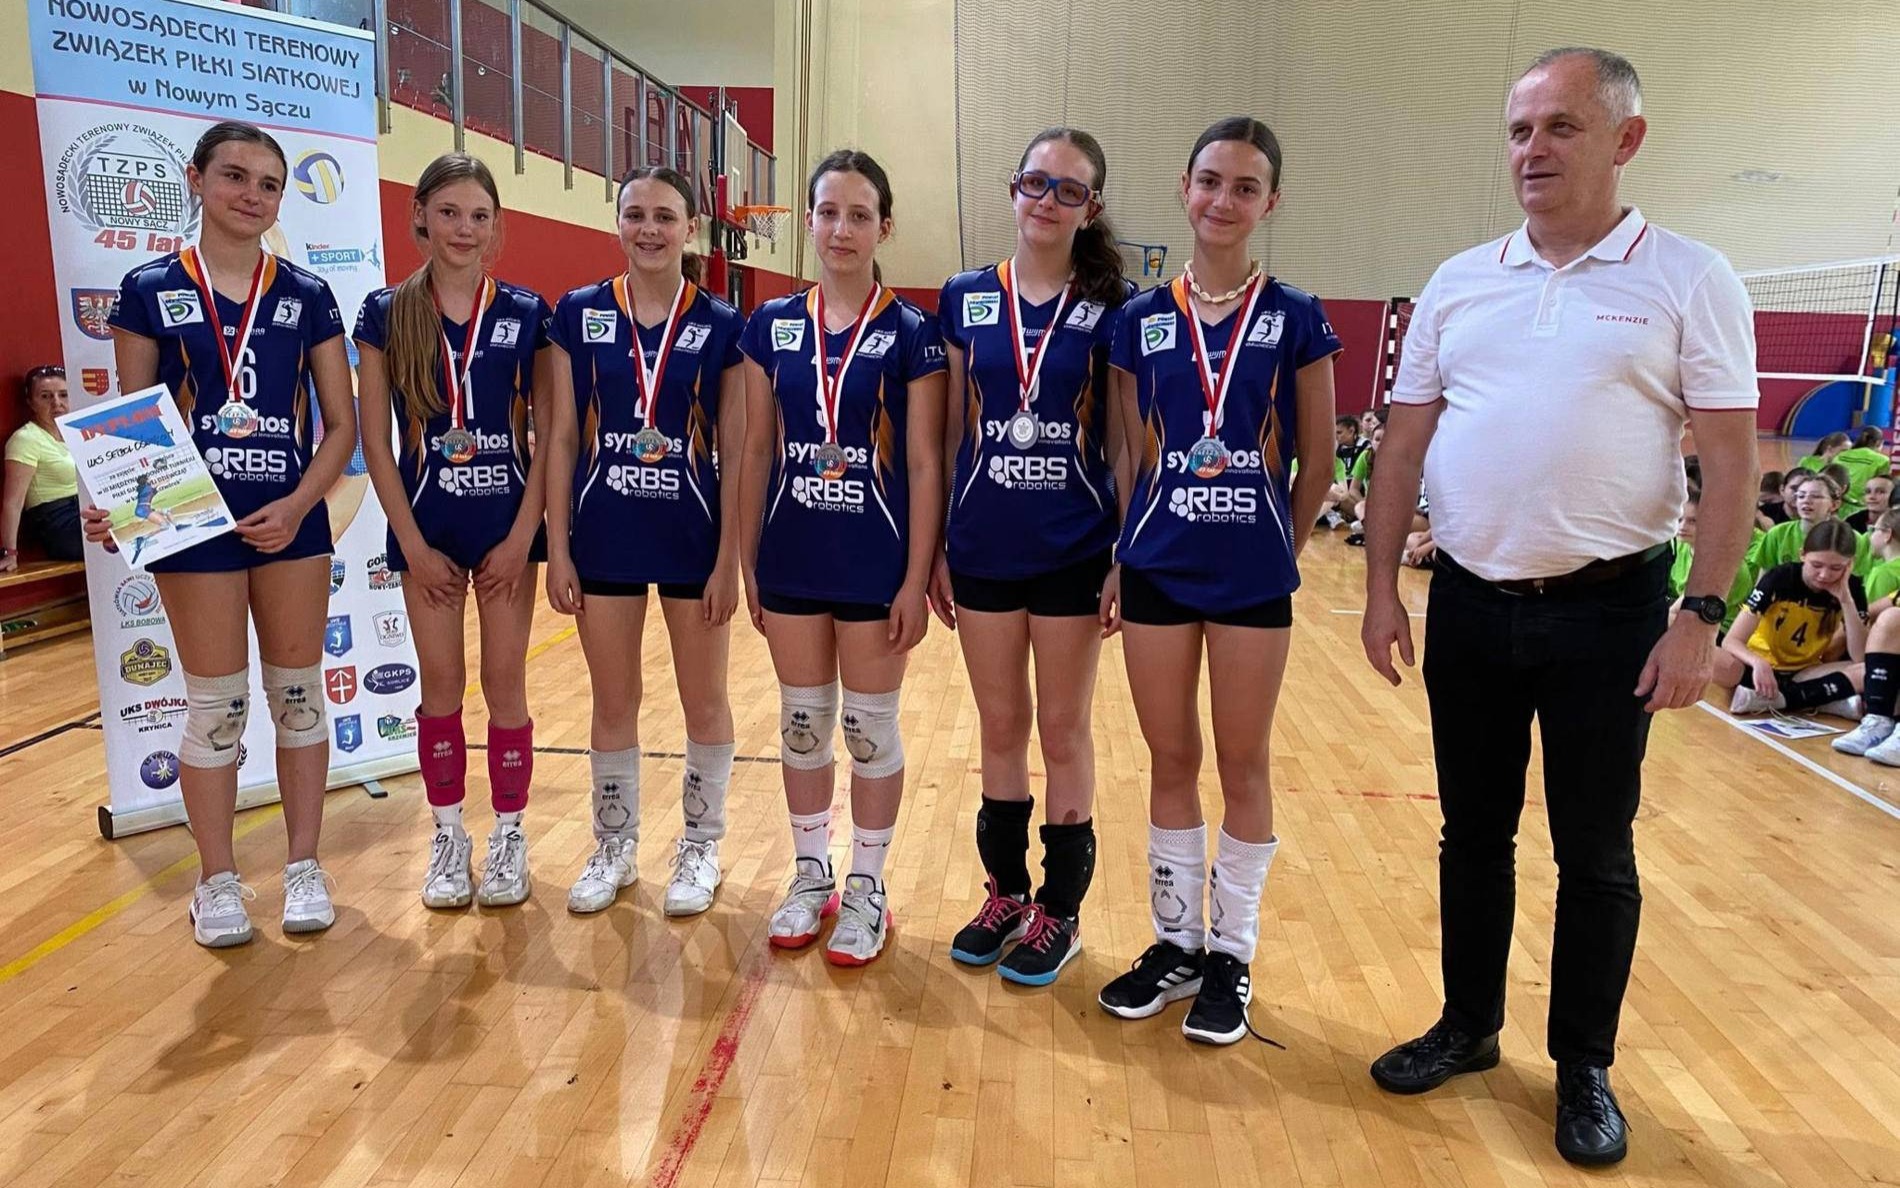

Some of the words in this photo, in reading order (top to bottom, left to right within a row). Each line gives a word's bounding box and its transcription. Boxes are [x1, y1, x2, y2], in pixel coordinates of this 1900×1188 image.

[48, 0, 236, 47] NOWOSĄDECKI
[244, 31, 360, 69] TERENOWY
[52, 30, 168, 66] ZWIĄZEK
[176, 50, 234, 77] PIŁKI
[242, 62, 360, 99] SIATKOWEJ
[128, 79, 147, 95] w
[156, 78, 237, 110] Nowym
[245, 93, 311, 119] Sączu
[77, 123, 131, 144] TERENOWY
[97, 157, 166, 179] TZPS
[110, 216, 141, 227] NOWY
[94, 229, 137, 250] 45
[146, 232, 185, 253] lat
[1596, 315, 1649, 325] MCKENZIE
[222, 447, 287, 473] RBS
[1004, 456, 1068, 481] RBS
[233, 471, 287, 482] robotics
[452, 465, 509, 488] RBS
[621, 465, 680, 491] RBS
[1013, 480, 1067, 490] robotics
[463, 486, 510, 496] robotics
[629, 489, 680, 500] robotics
[804, 476, 864, 504] RBS
[1187, 486, 1257, 513] RBS
[813, 501, 864, 513] robotics
[1197, 512, 1256, 524] robotics
[1790, 621, 1808, 647] 4
[125, 660, 167, 674] DUNAJEC
[384, 668, 411, 679] GKPS
[120, 703, 142, 718] UKS
[144, 697, 189, 710] DWÓJKA
[138, 722, 172, 733] KRYNICA
